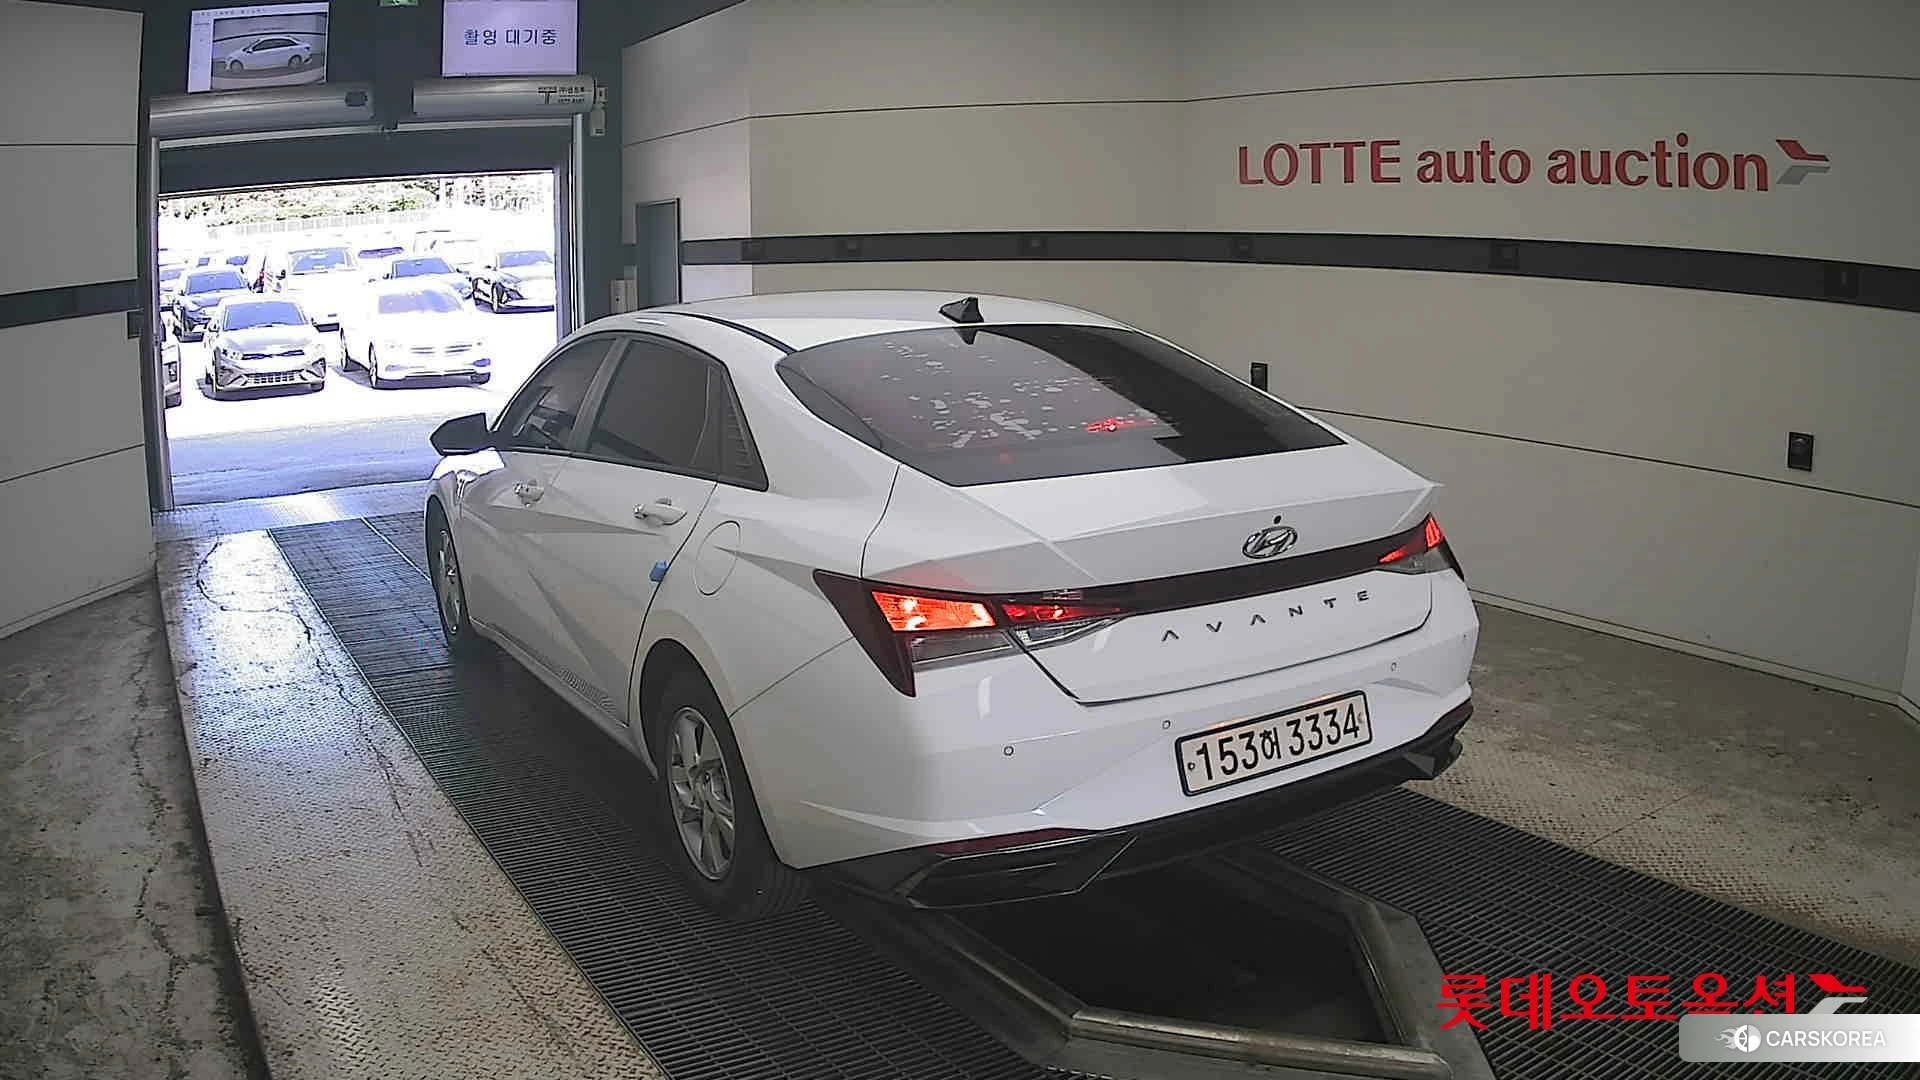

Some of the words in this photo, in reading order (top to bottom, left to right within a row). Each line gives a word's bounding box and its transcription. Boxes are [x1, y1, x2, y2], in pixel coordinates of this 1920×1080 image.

[464, 29, 497, 46] 촬영
[505, 29, 558, 46] 대기중
[1239, 140, 1401, 185] LOTTE
[1416, 140, 1532, 184] auto
[1548, 132, 1769, 192] auction
[1161, 590, 1370, 642] AVANTE
